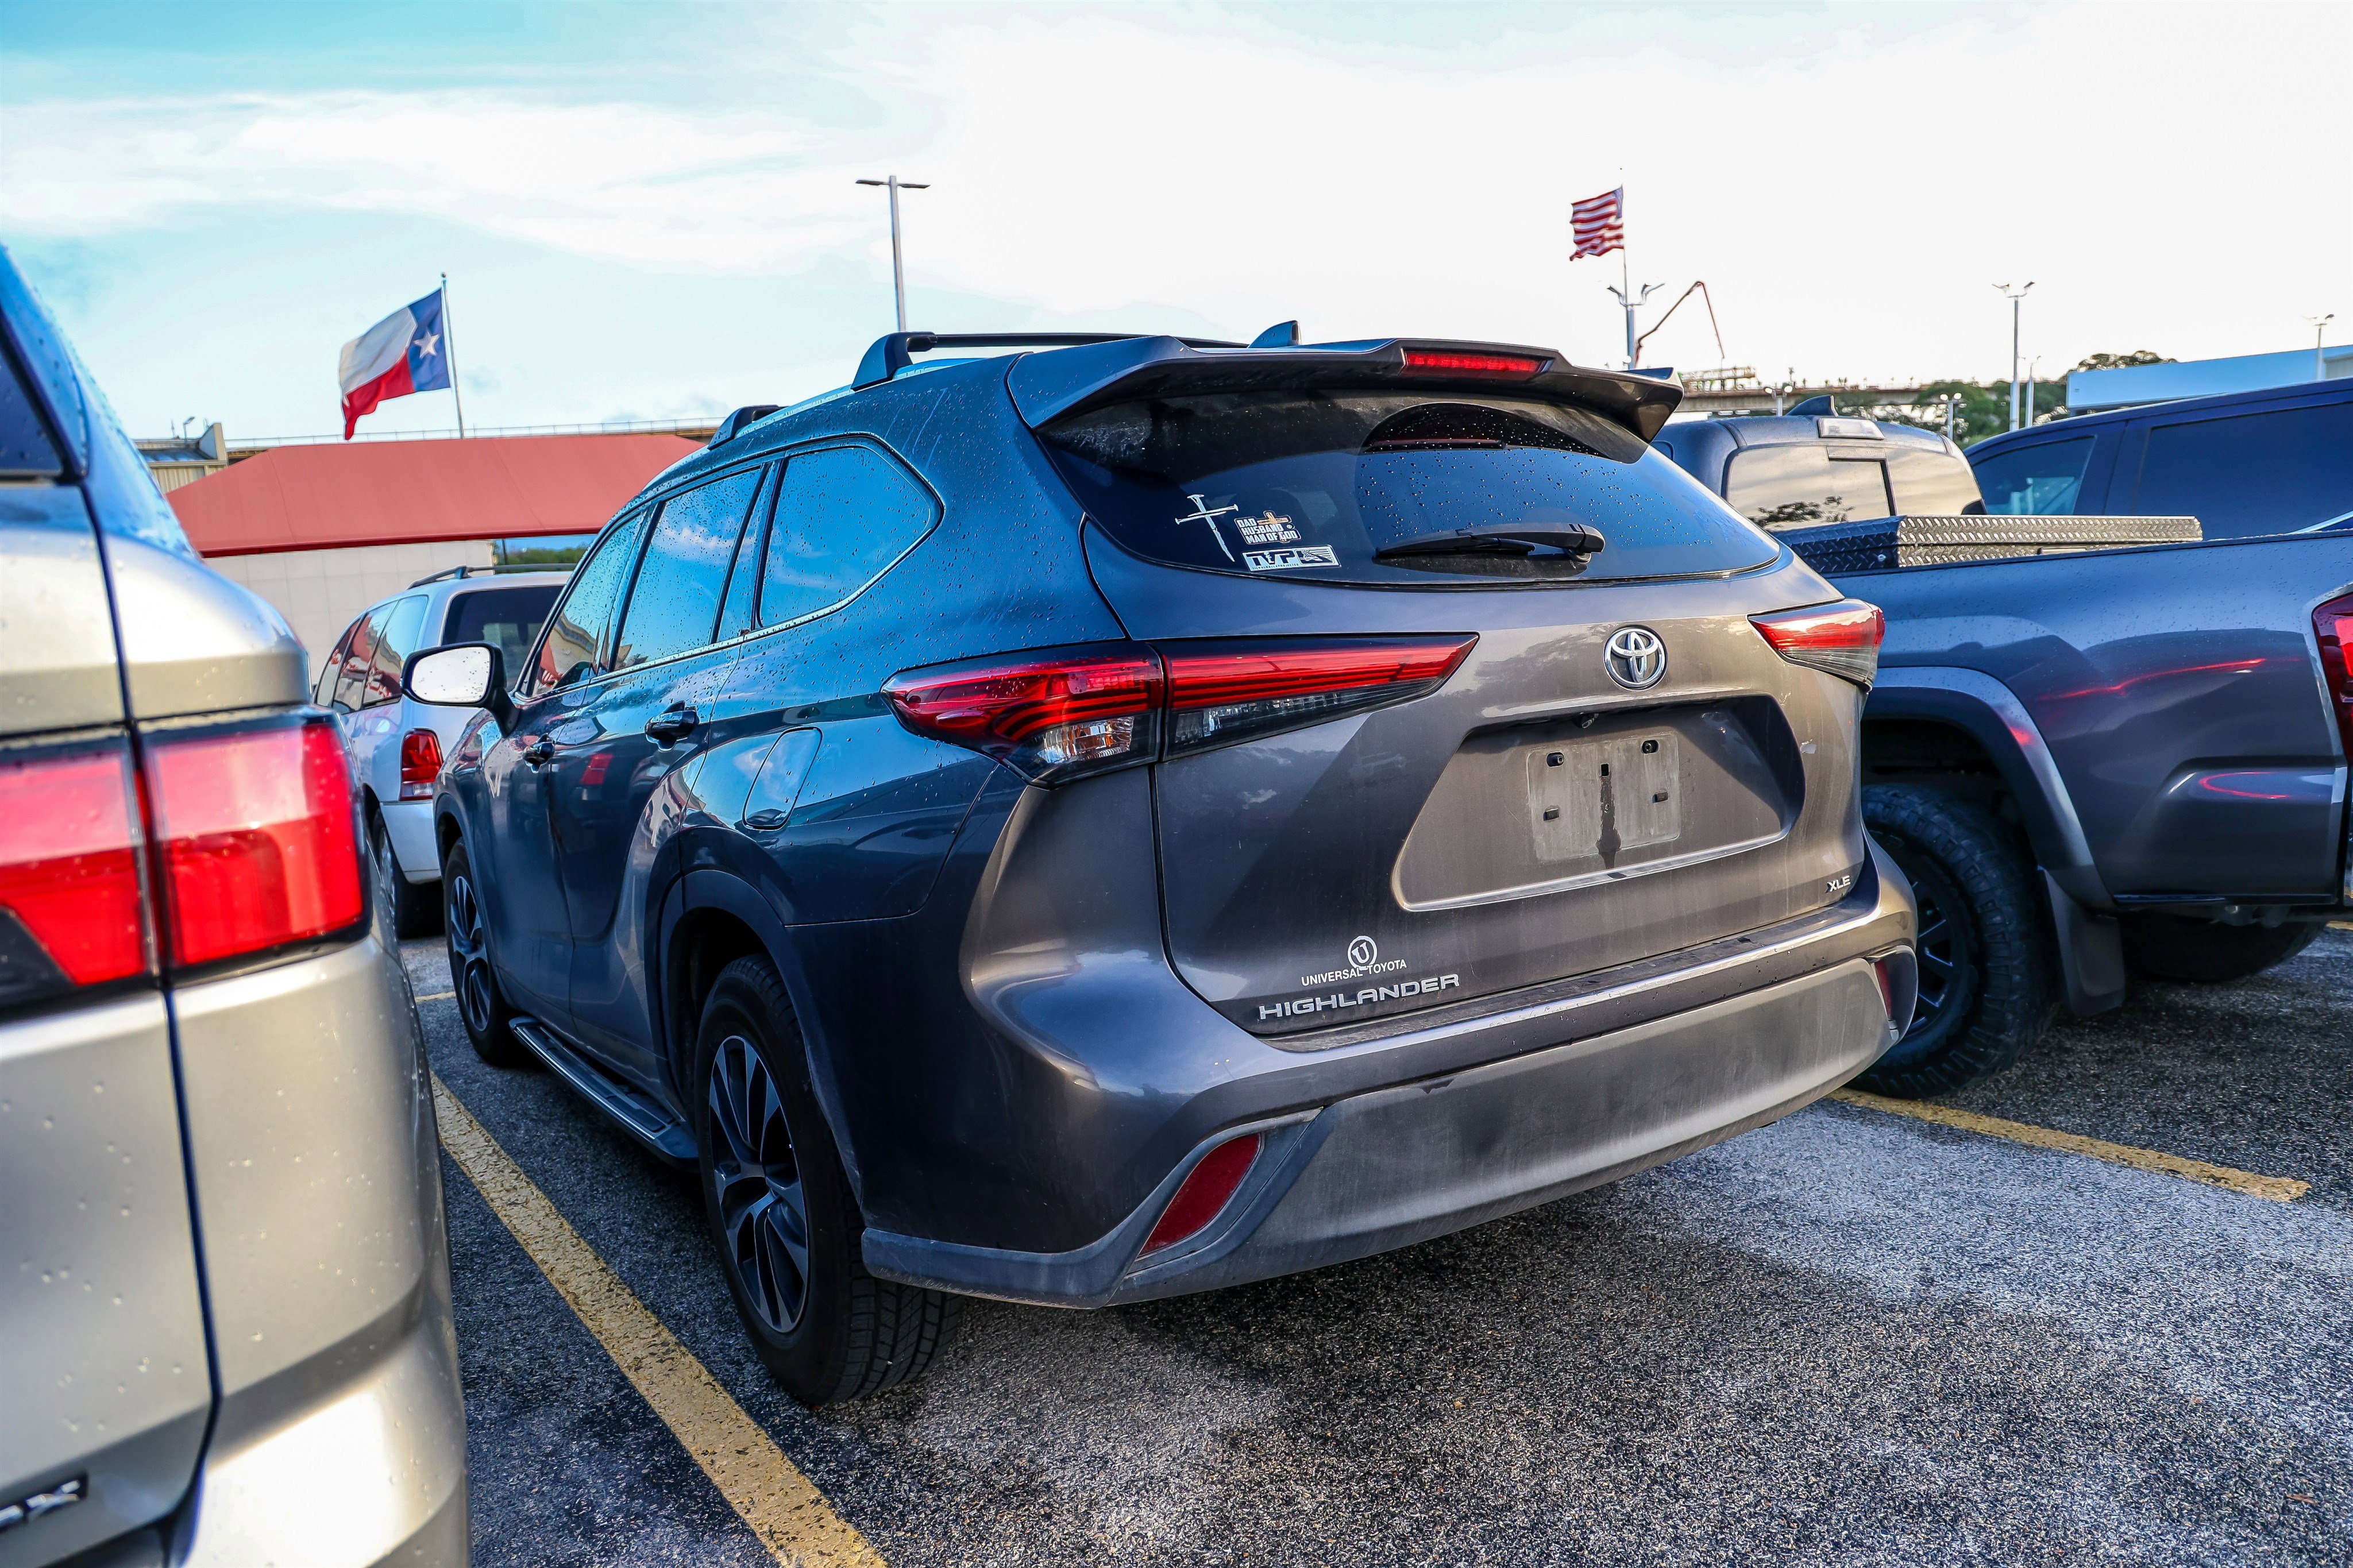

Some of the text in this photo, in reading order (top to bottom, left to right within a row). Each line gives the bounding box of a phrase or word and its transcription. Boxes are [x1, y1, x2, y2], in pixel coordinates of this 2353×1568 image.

[1236, 518, 1257, 527] DAD
[1241, 524, 1284, 535] HUSBAND
[1245, 530, 1298, 544] MAN OF GOD
[1245, 550, 1296, 566] TVP
[1827, 875, 1851, 893] XLE
[1301, 959, 1407, 987] UNIVERSAL TOYOTA
[1259, 974, 1460, 1020] HIGHLANDER
